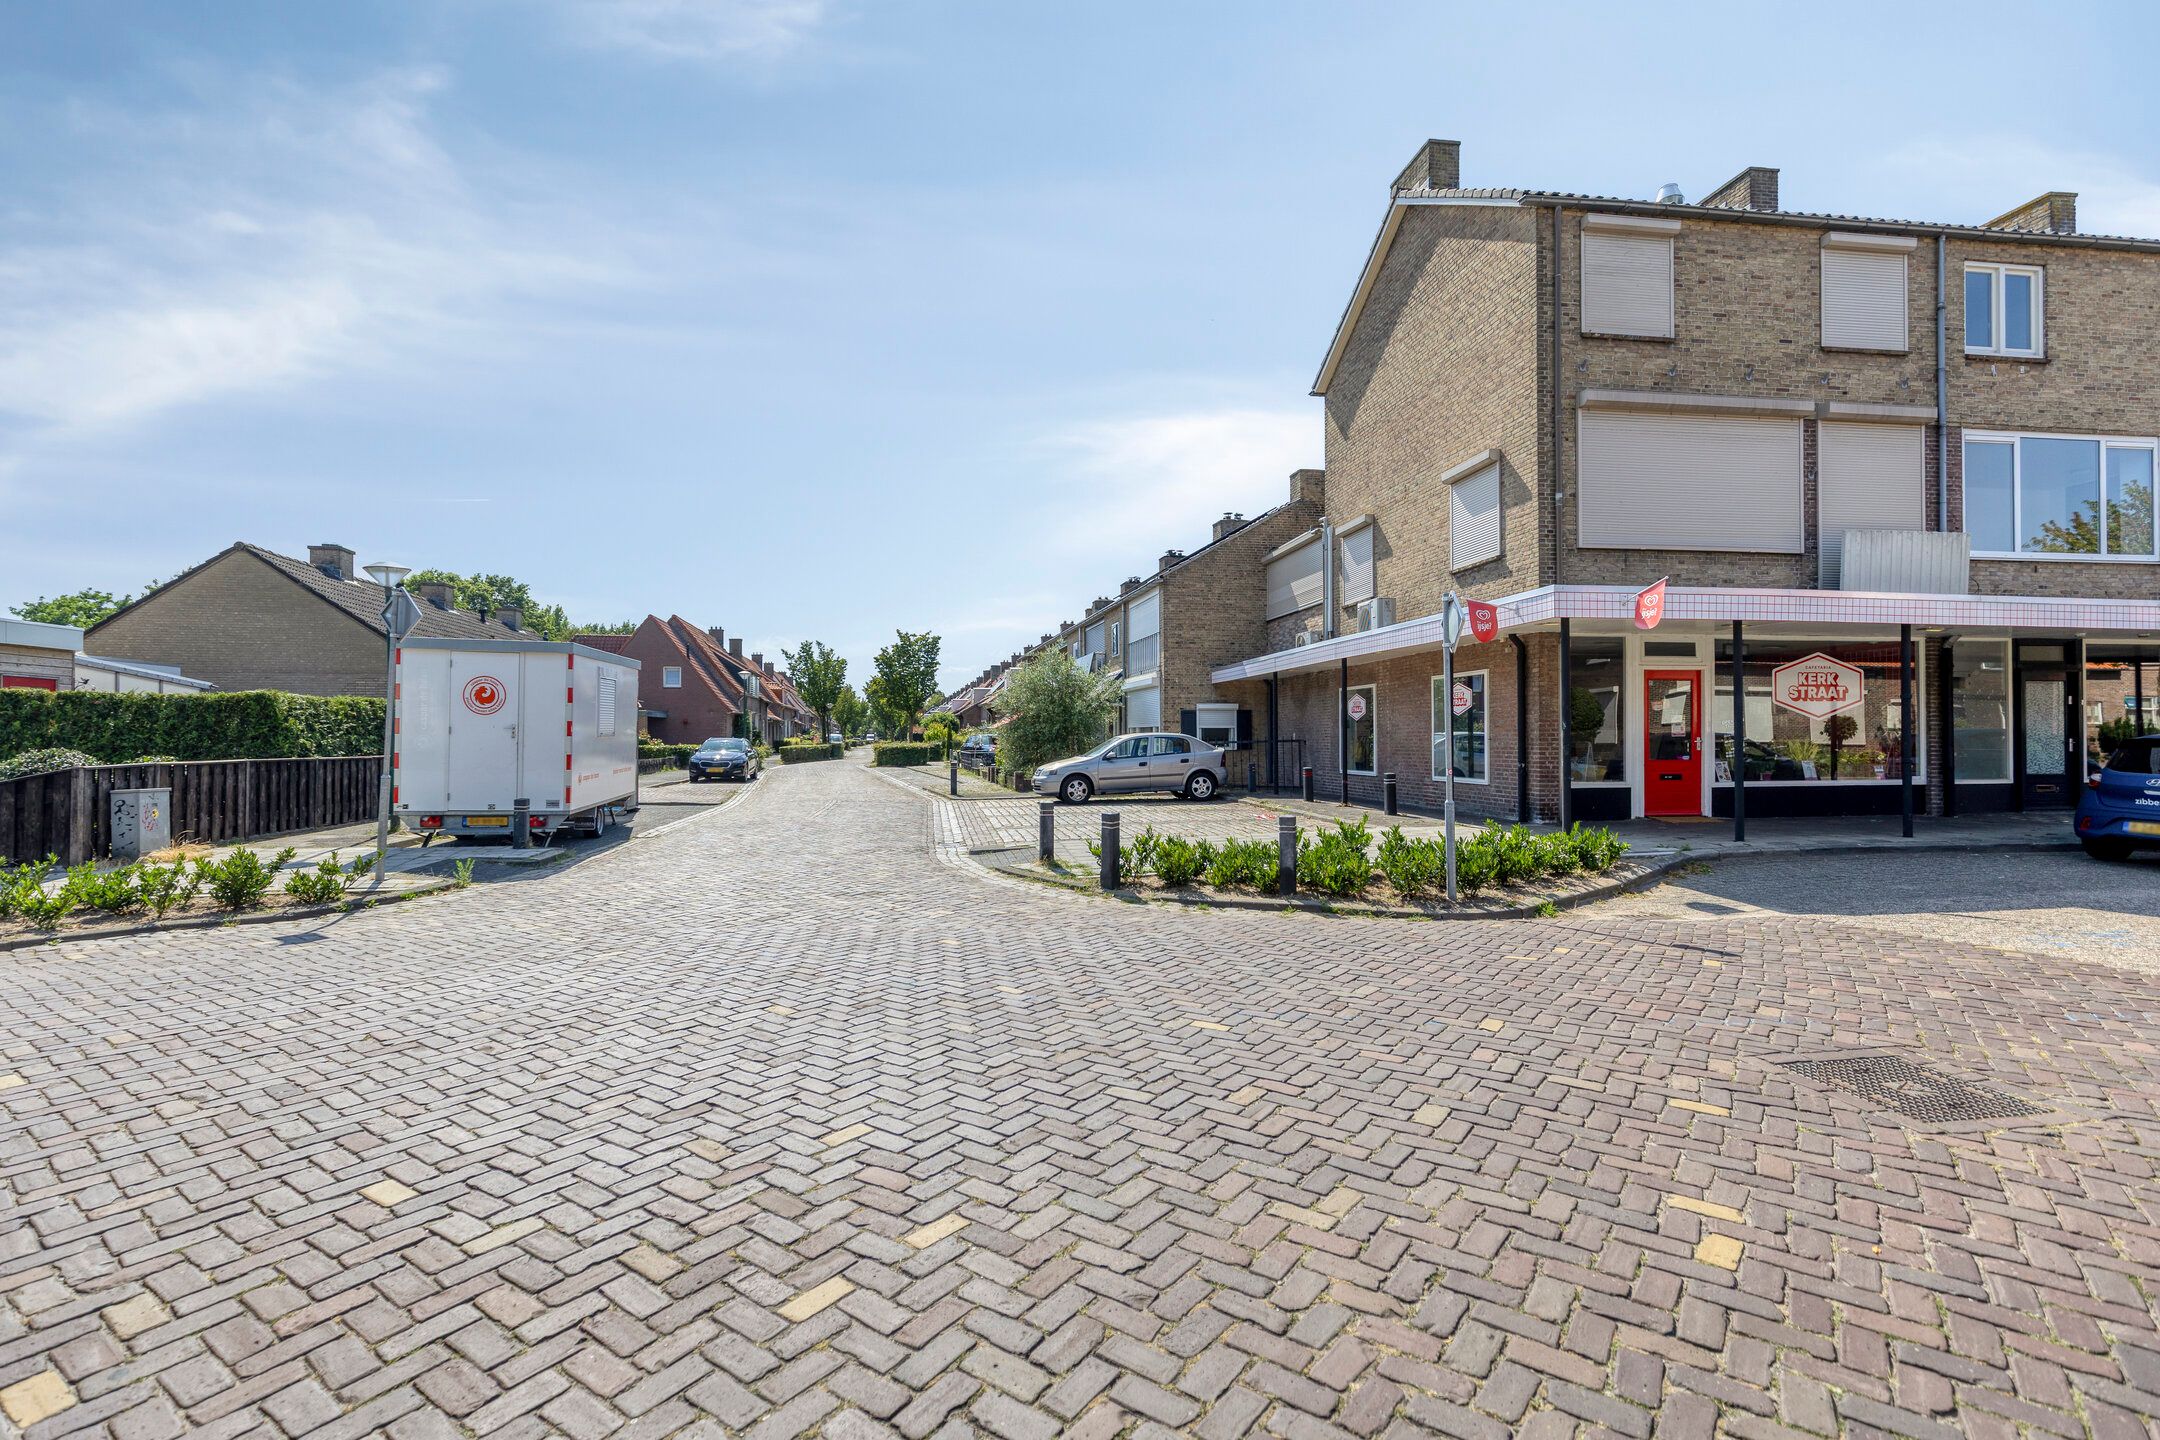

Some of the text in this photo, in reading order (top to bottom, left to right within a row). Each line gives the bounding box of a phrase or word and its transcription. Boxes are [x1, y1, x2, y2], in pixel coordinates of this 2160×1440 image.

[1477, 620, 1492, 632] ijsje?
[1798, 671, 1839, 686] KERK
[1788, 685, 1848, 702] STRAAT
